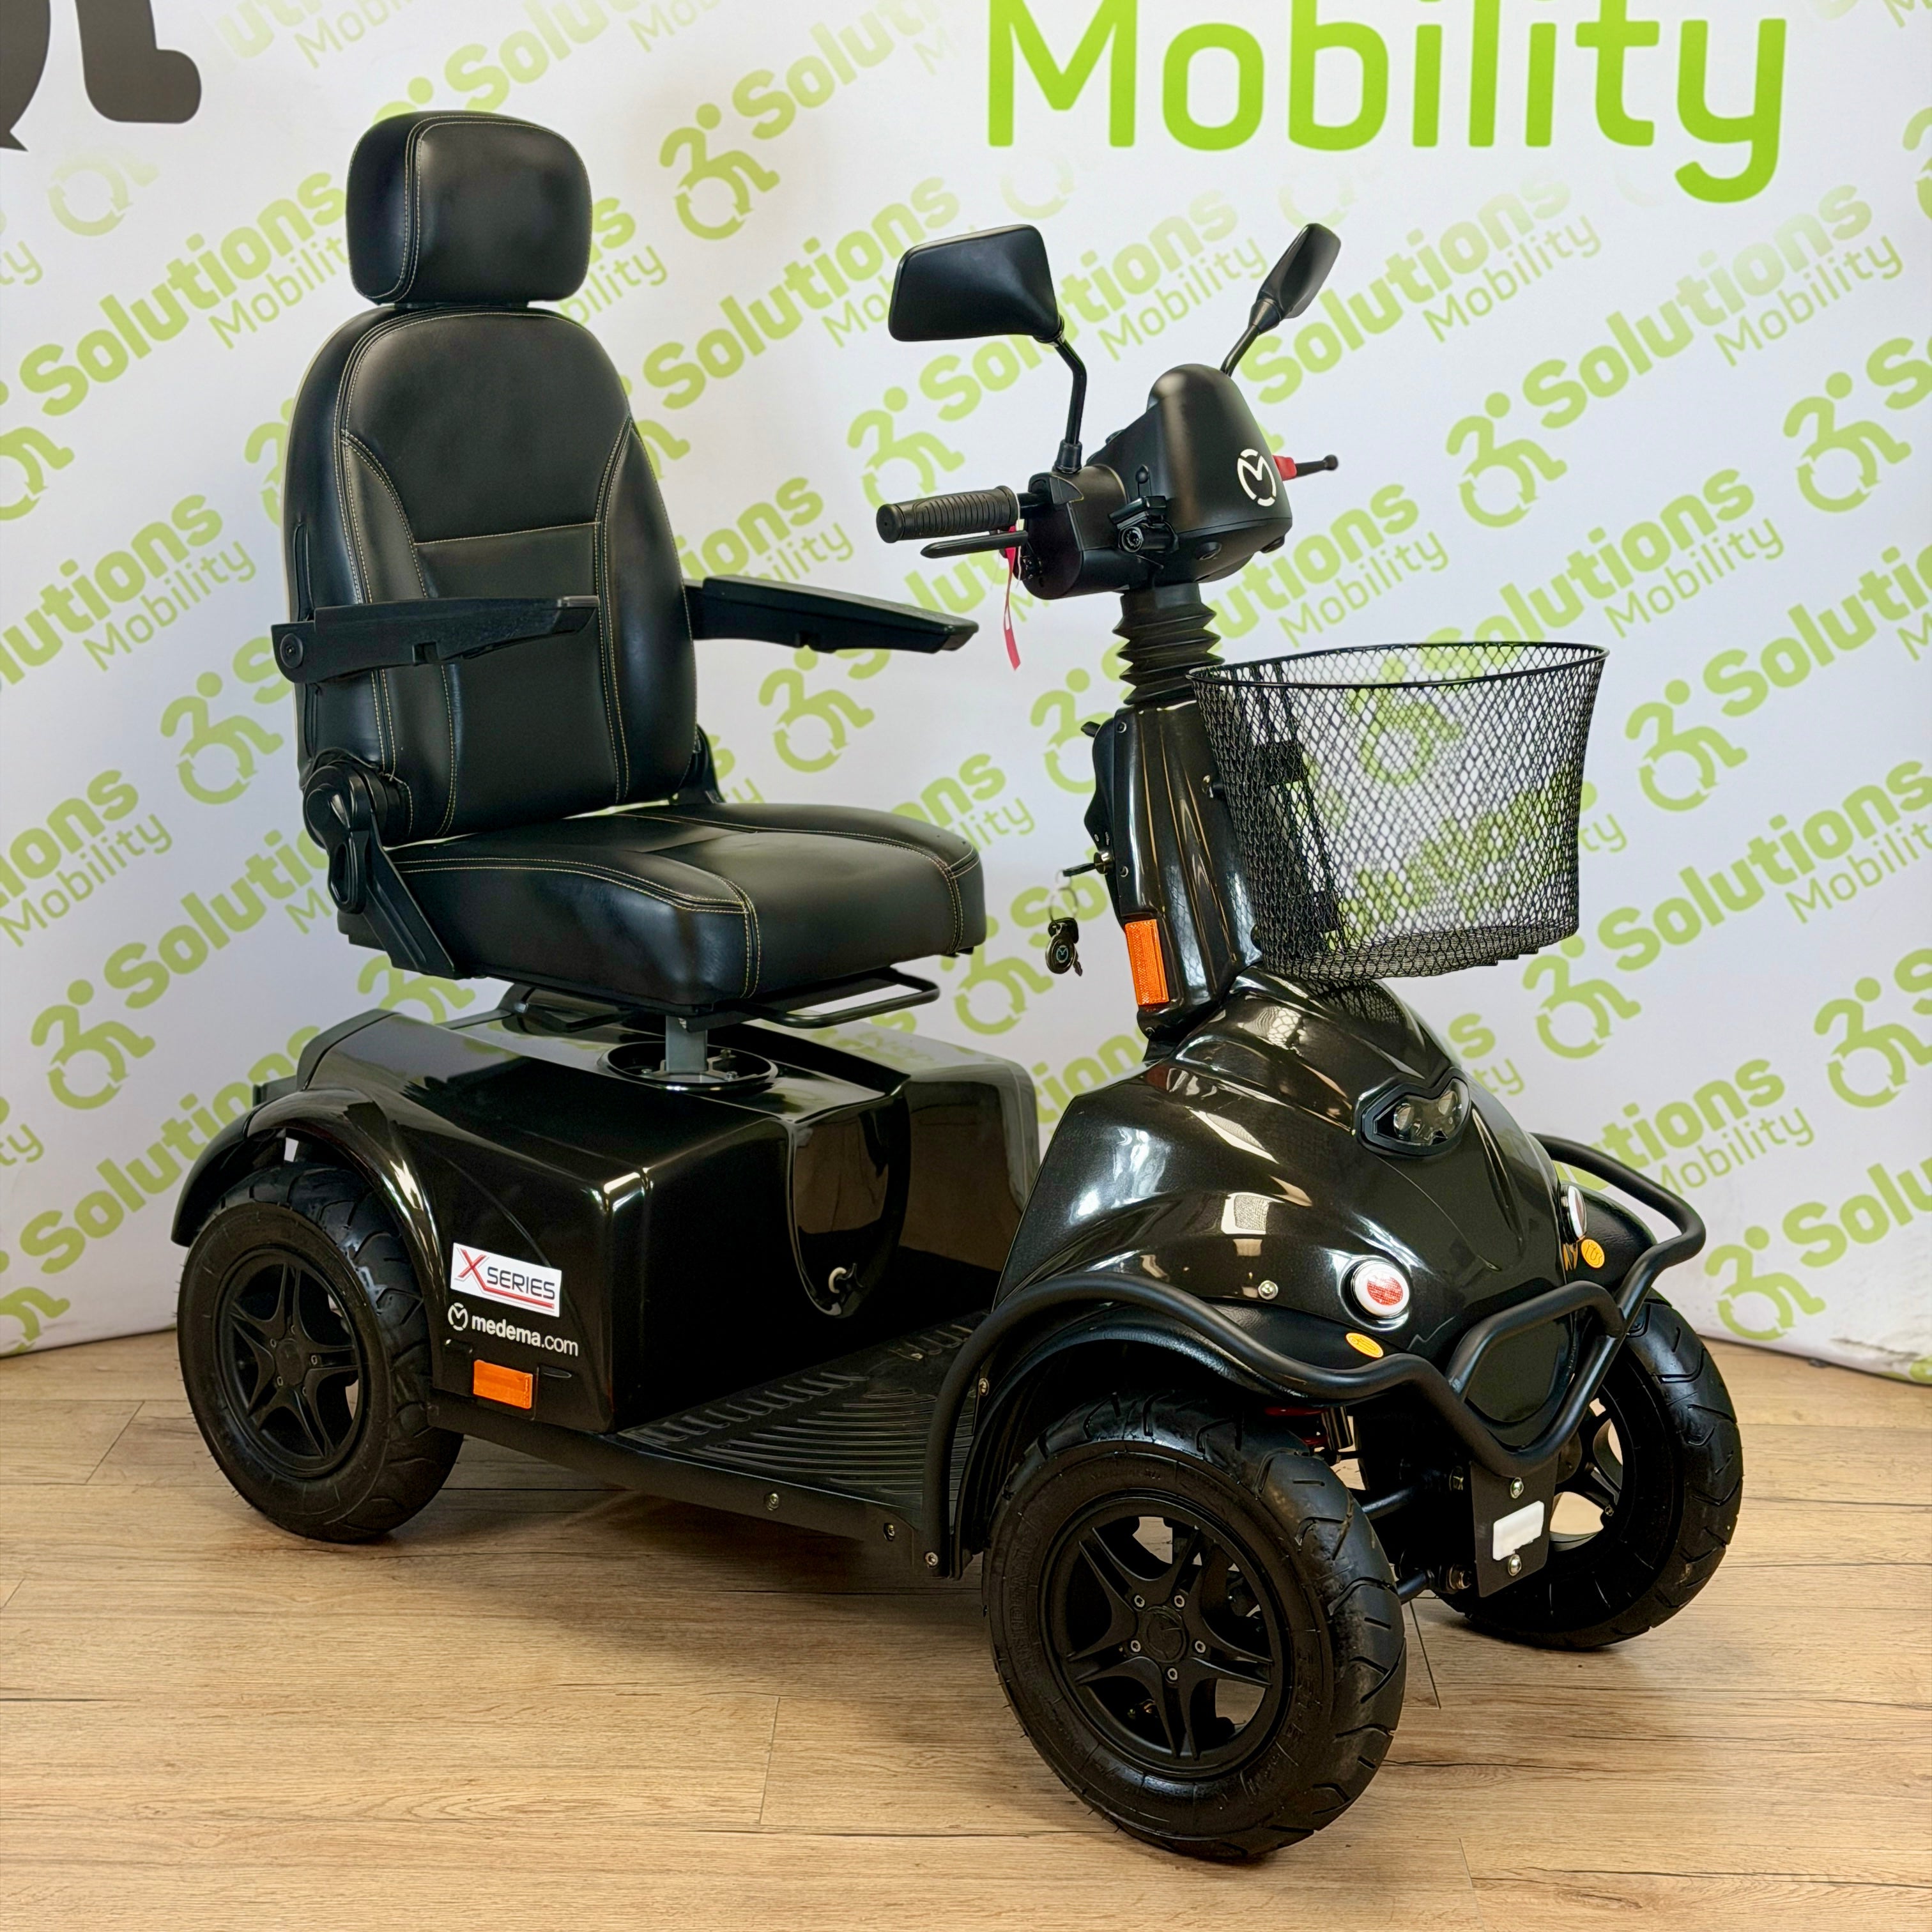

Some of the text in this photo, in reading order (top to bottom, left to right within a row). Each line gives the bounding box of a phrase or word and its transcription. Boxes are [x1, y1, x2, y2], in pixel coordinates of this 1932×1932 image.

[988, 0, 1787, 203] Mobility
[19, 172, 346, 415] Solutions
[208, 236, 348, 349] Mobilit
[643, 176, 960, 410] Solutions
[1098, 238, 1268, 362] Mobility
[1241, 169, 1572, 404] Solutions
[1422, 215, 1602, 343] Mobility
[1522, 185, 1873, 429] Solutions
[1713, 236, 1903, 367] Mobility
[82, 539, 256, 671] Mobility
[1279, 532, 1448, 648] Mobility
[1603, 518, 1784, 638] Mobility
[1703, 544, 1932, 717] Soluti
[0, 813, 172, 947] Mobility
[1785, 822, 1932, 924] Mobilit
[471, 1314, 578, 1356] medema.com
[486, 1266, 555, 1301] SERIES
